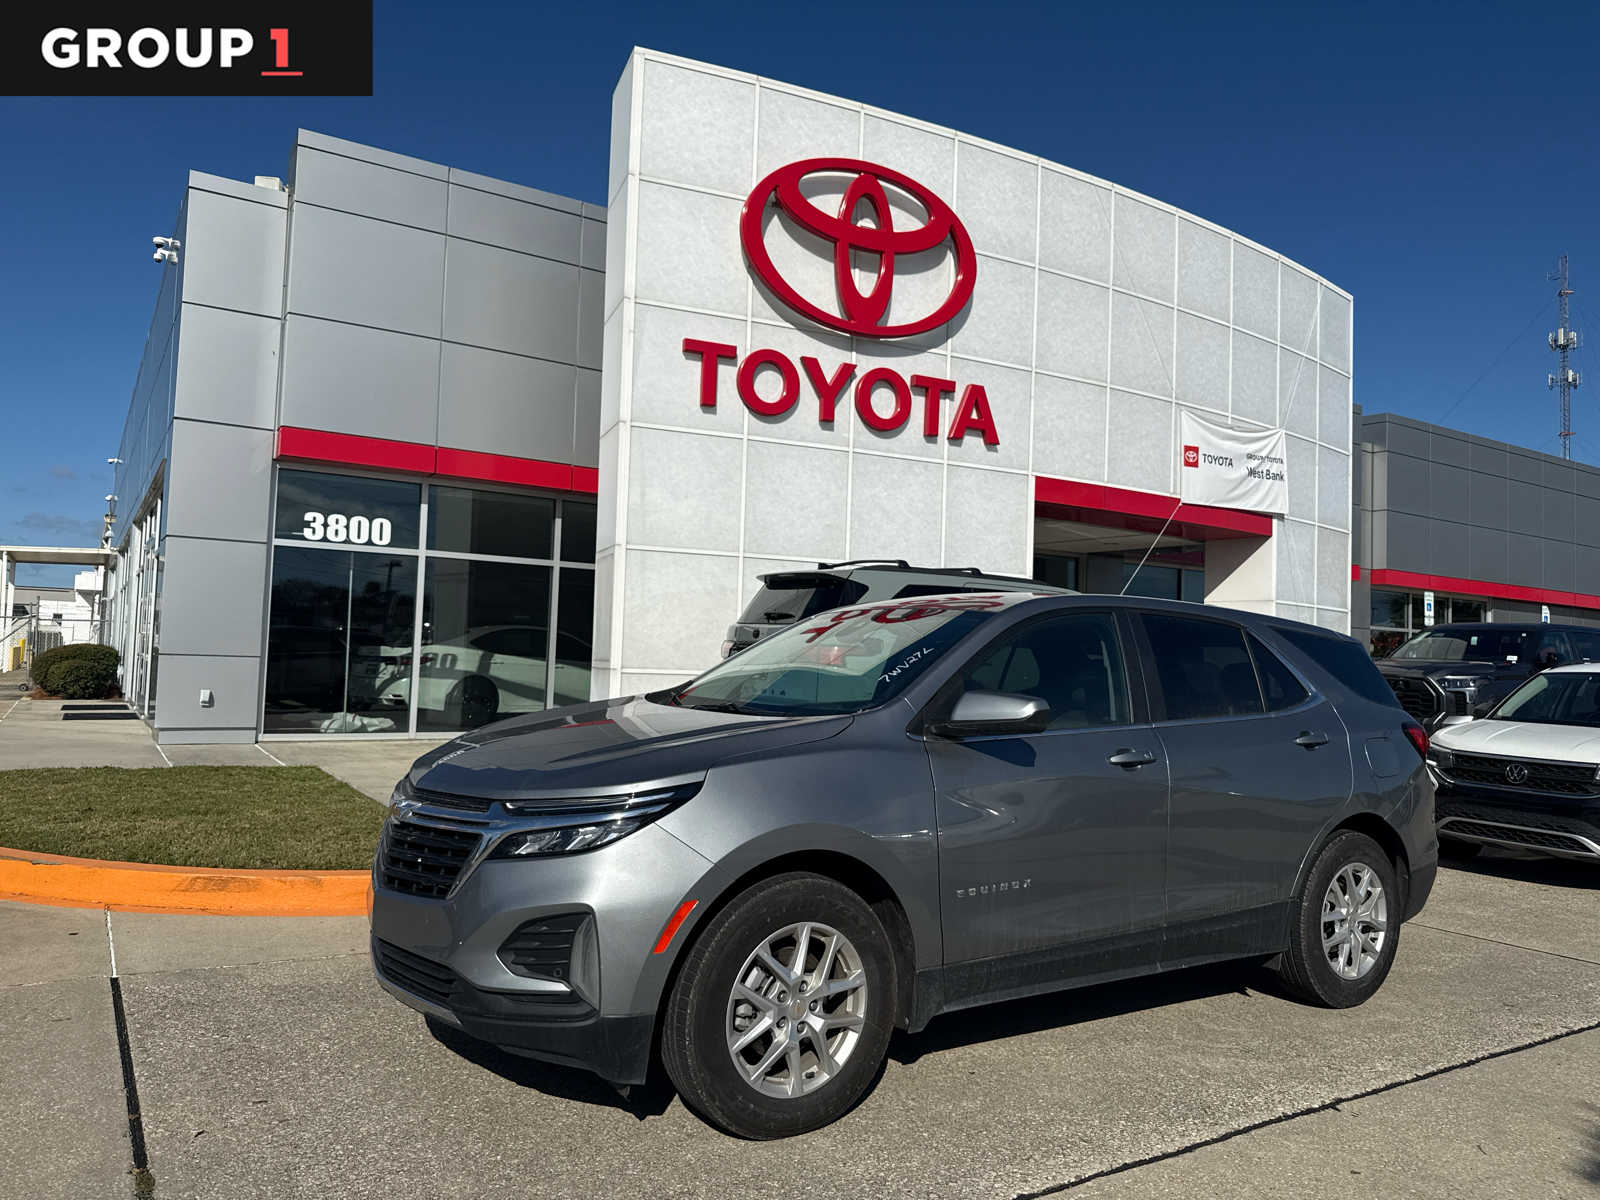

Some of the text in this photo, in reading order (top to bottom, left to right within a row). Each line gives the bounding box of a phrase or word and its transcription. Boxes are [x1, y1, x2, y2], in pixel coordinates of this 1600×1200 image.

[682, 338, 1000, 446] TOYOTA
[1202, 453, 1233, 468] TOYOTA
[1246, 466, 1284, 481] West Bank
[303, 511, 392, 546] 3800
